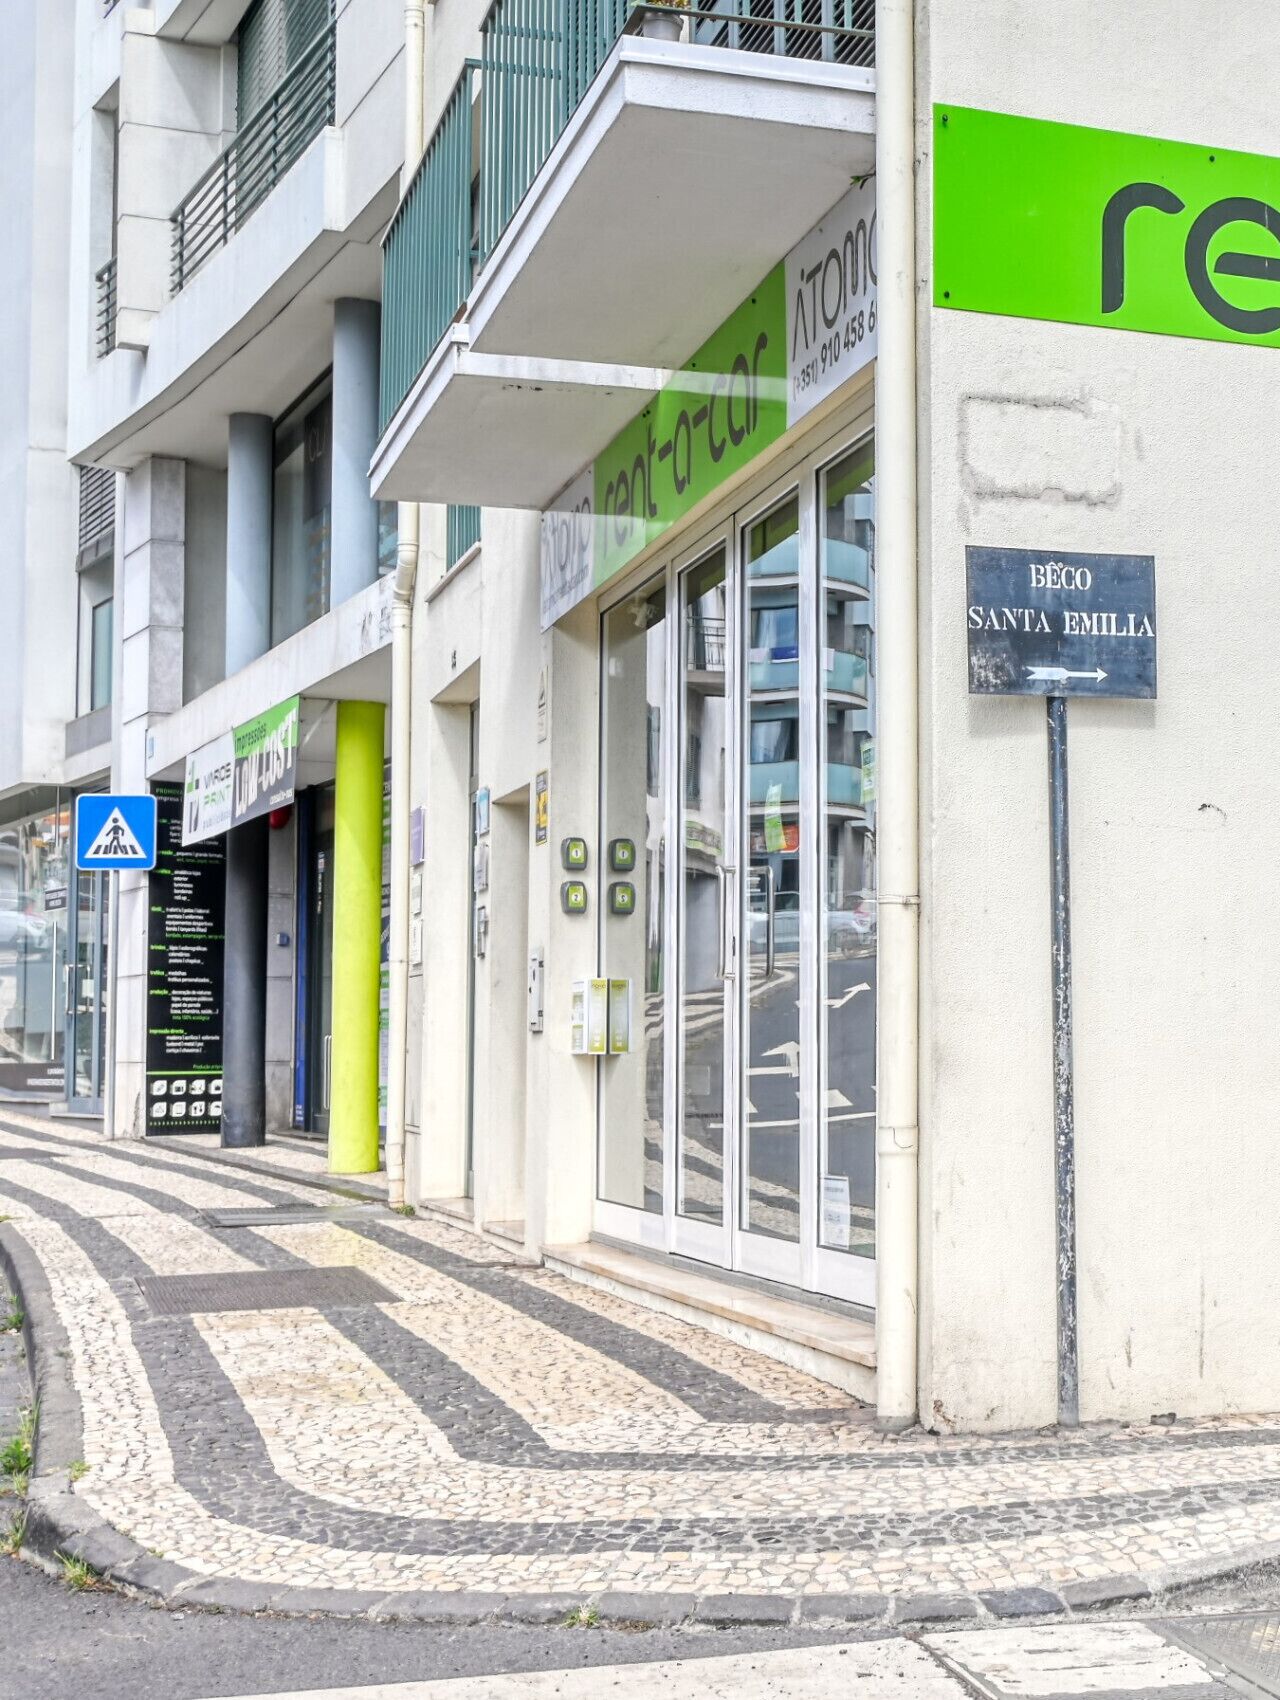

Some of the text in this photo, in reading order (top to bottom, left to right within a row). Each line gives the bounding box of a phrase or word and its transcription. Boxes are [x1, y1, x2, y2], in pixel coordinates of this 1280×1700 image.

[793, 358, 818, 401] (+351)
[821, 331, 841, 374] 910
[843, 310, 865, 353] 458
[603, 331, 769, 561] rent-a-car
[968, 606, 1156, 637] SANTA EMILIA
